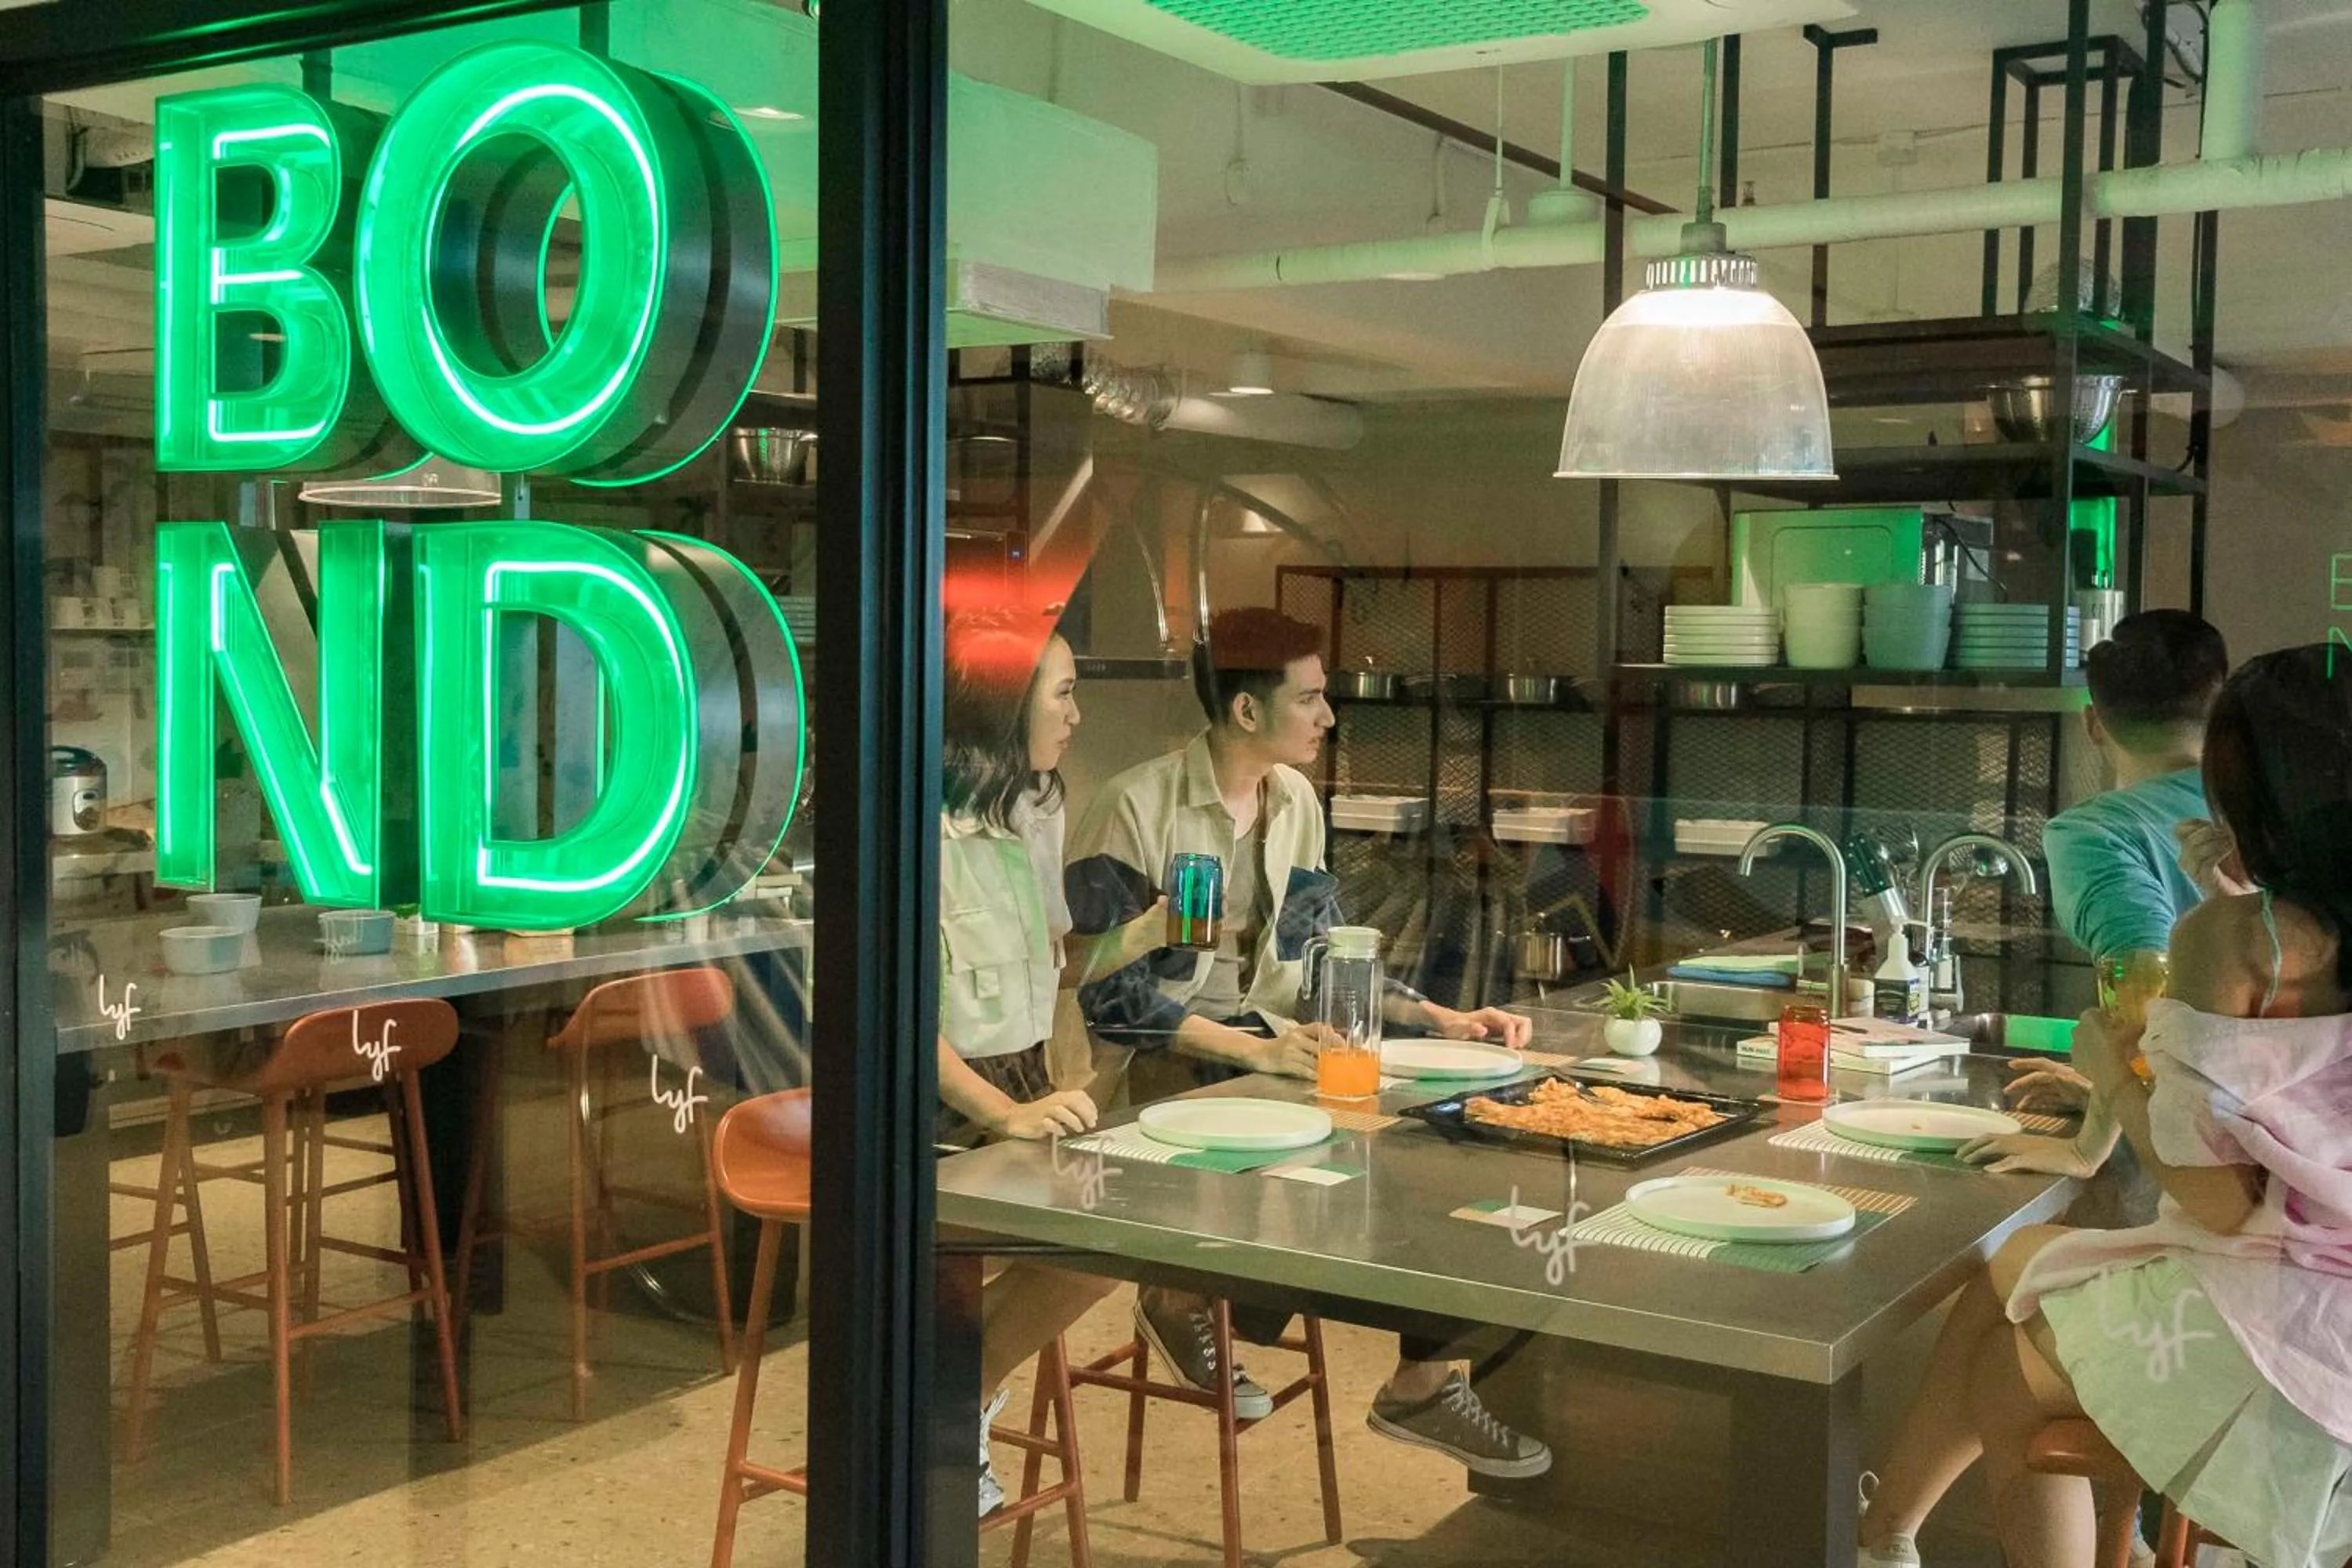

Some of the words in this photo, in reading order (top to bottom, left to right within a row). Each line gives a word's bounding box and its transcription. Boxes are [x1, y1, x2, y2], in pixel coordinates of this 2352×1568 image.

[157, 38, 668, 472] BO
[157, 521, 699, 928] ND
[99, 974, 141, 1040] lyf
[351, 1008, 401, 1081] lyf
[652, 1054, 709, 1134] lyf
[1052, 1127, 1123, 1210] lyf
[1510, 1185, 1601, 1286] lyf
[2097, 1265, 2217, 1383] lyf
